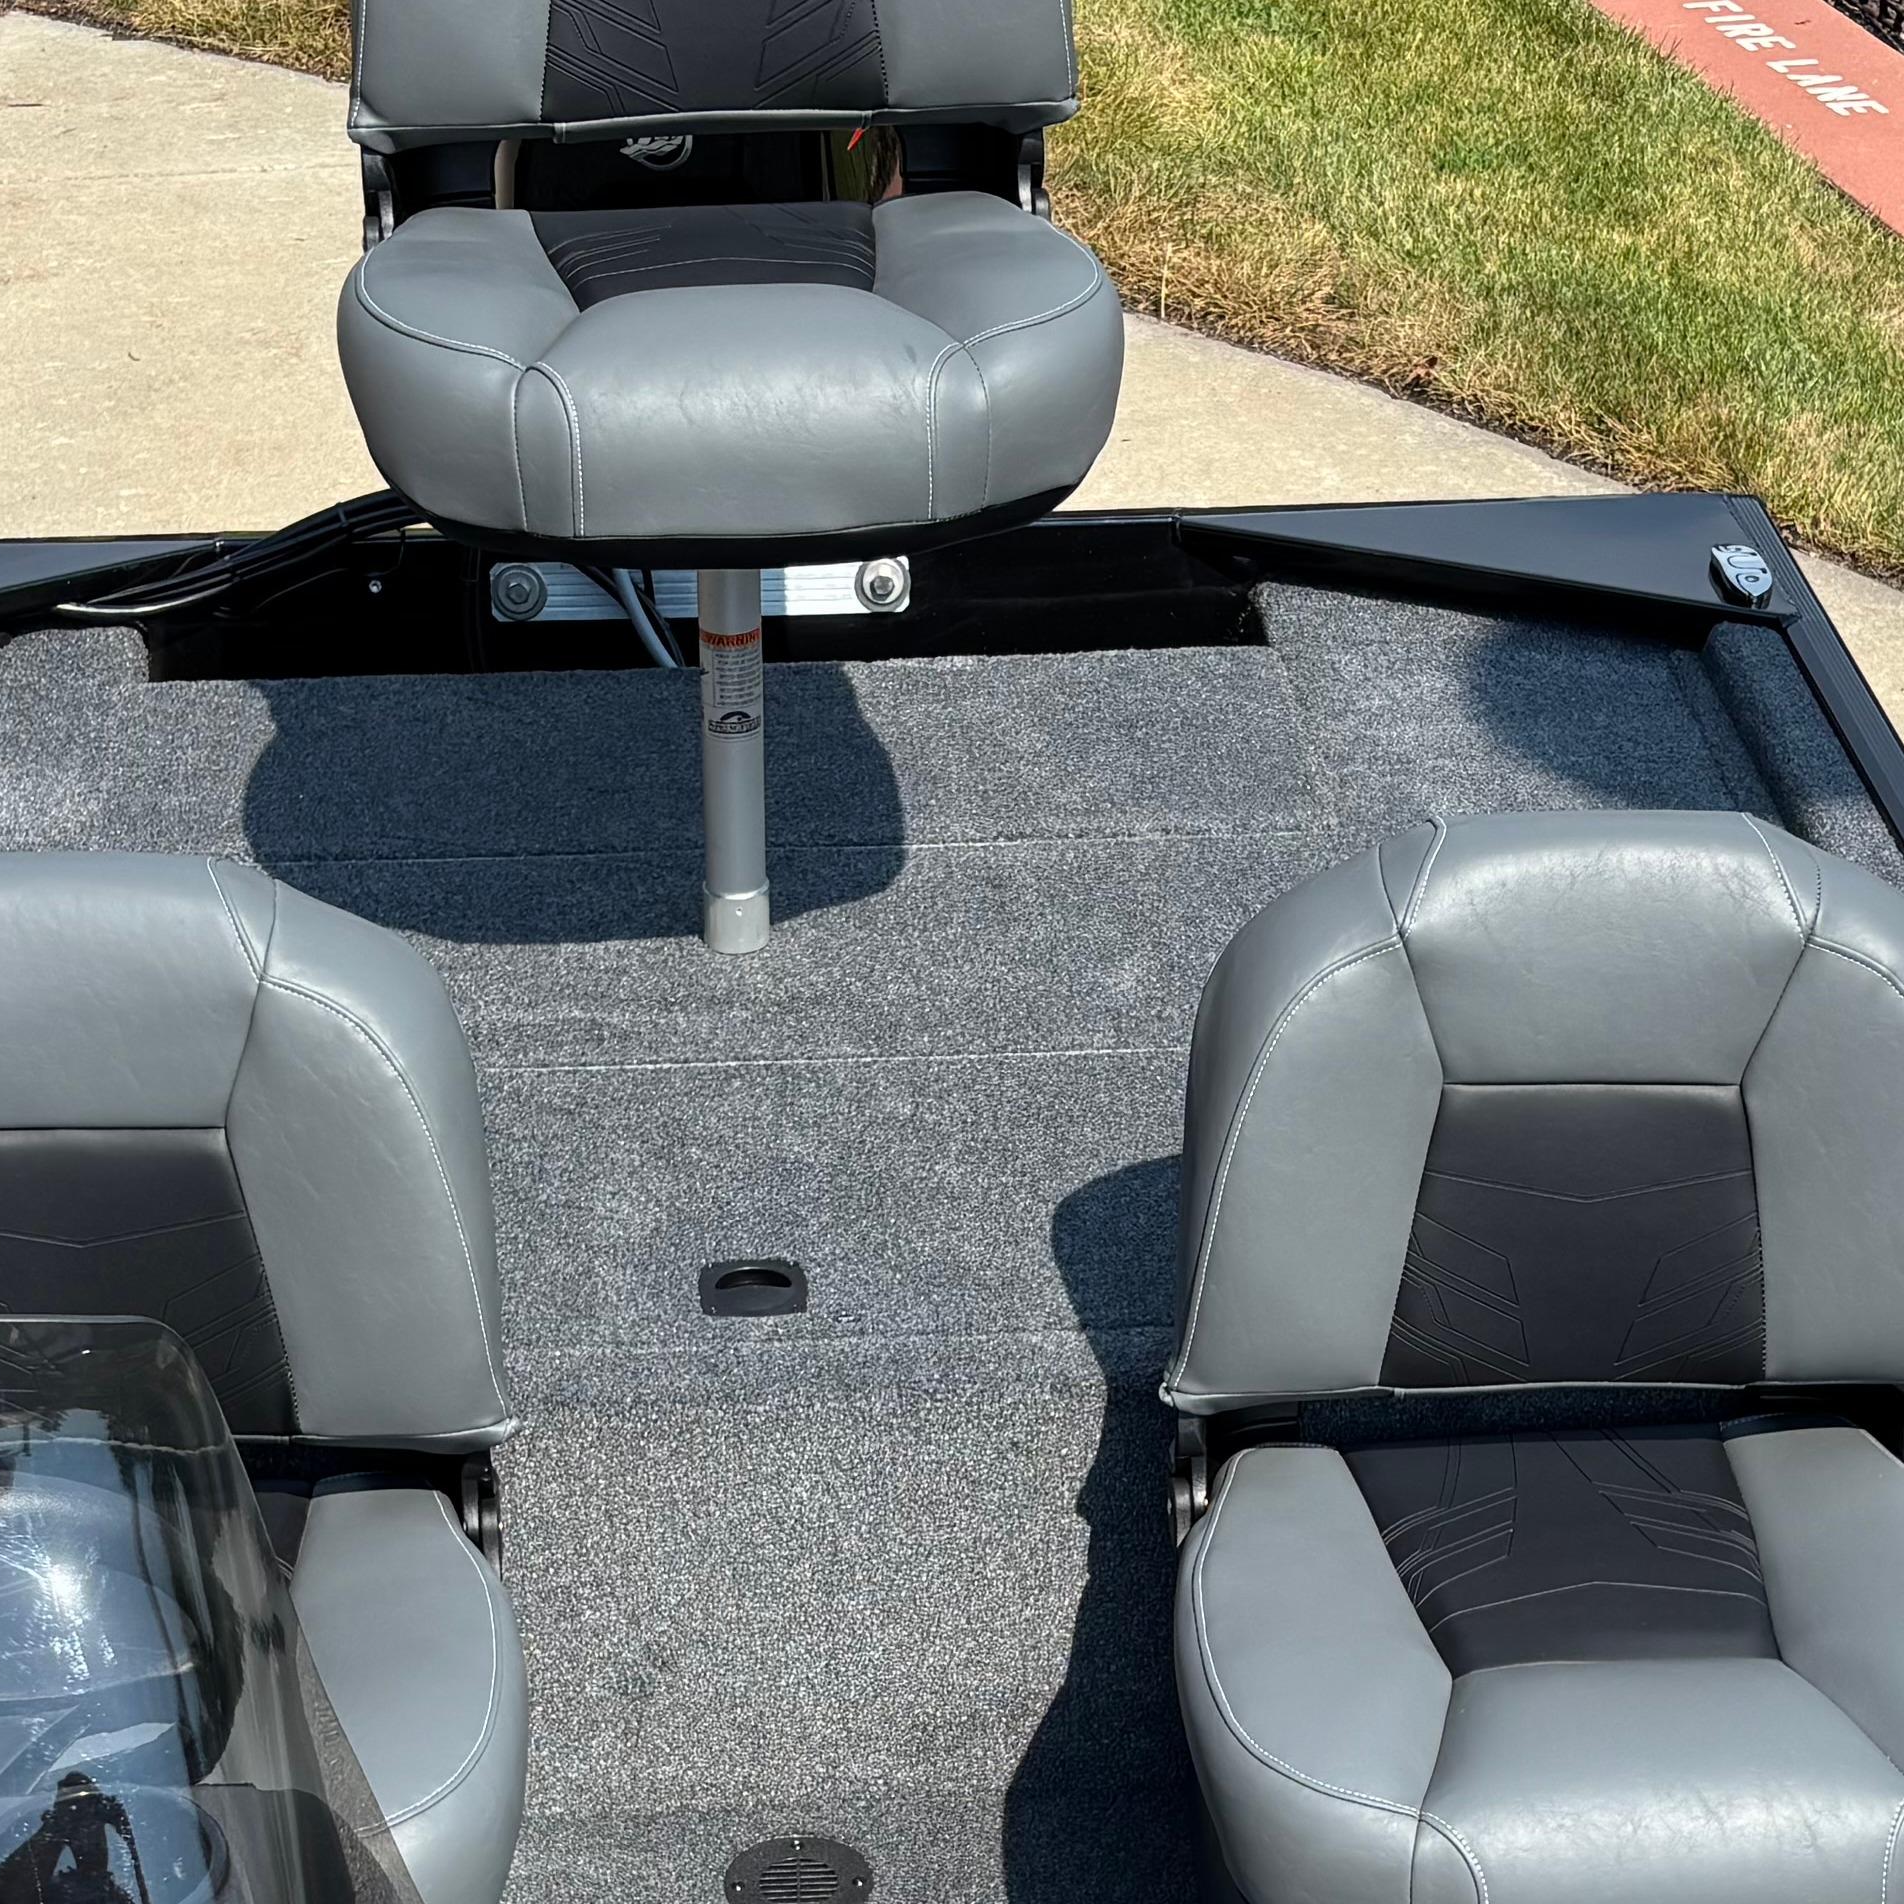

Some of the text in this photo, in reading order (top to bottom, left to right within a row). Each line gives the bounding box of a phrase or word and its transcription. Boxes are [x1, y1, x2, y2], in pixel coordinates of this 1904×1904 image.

[1682, 0, 1889, 116] FIRE LANE
[702, 631, 761, 648] WARNIN
